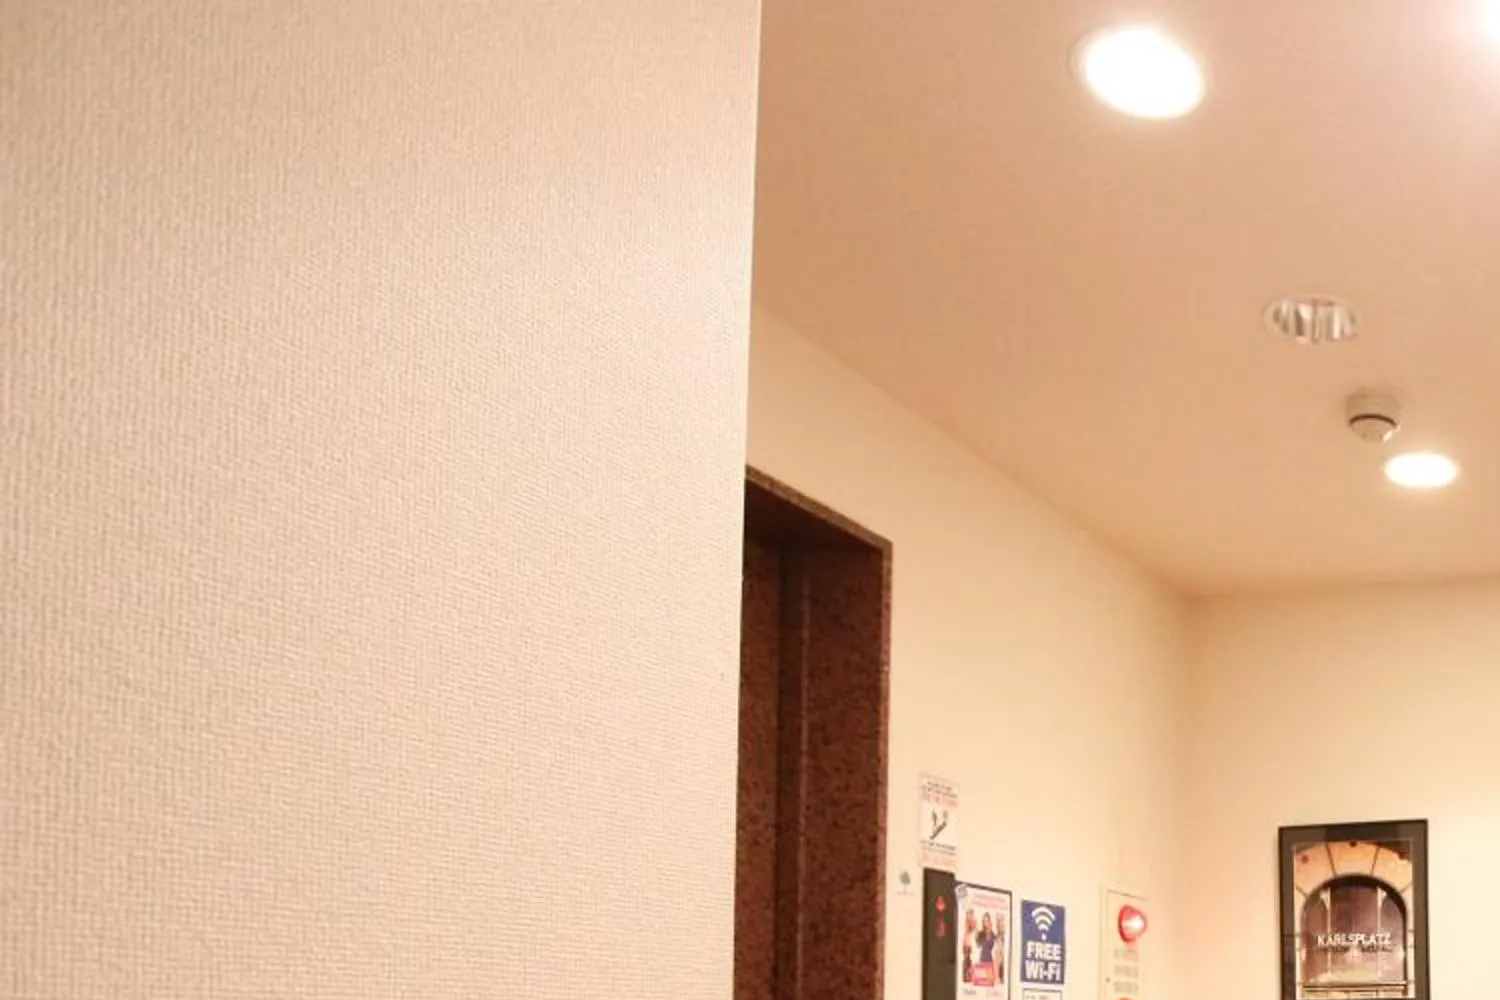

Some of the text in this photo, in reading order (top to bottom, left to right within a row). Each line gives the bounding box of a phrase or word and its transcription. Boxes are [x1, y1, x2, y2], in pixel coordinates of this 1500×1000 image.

[1317, 932, 1392, 945] KARLSPLATZ
[1027, 941, 1062, 961] FREE
[1025, 960, 1061, 981] Wi-Fi
